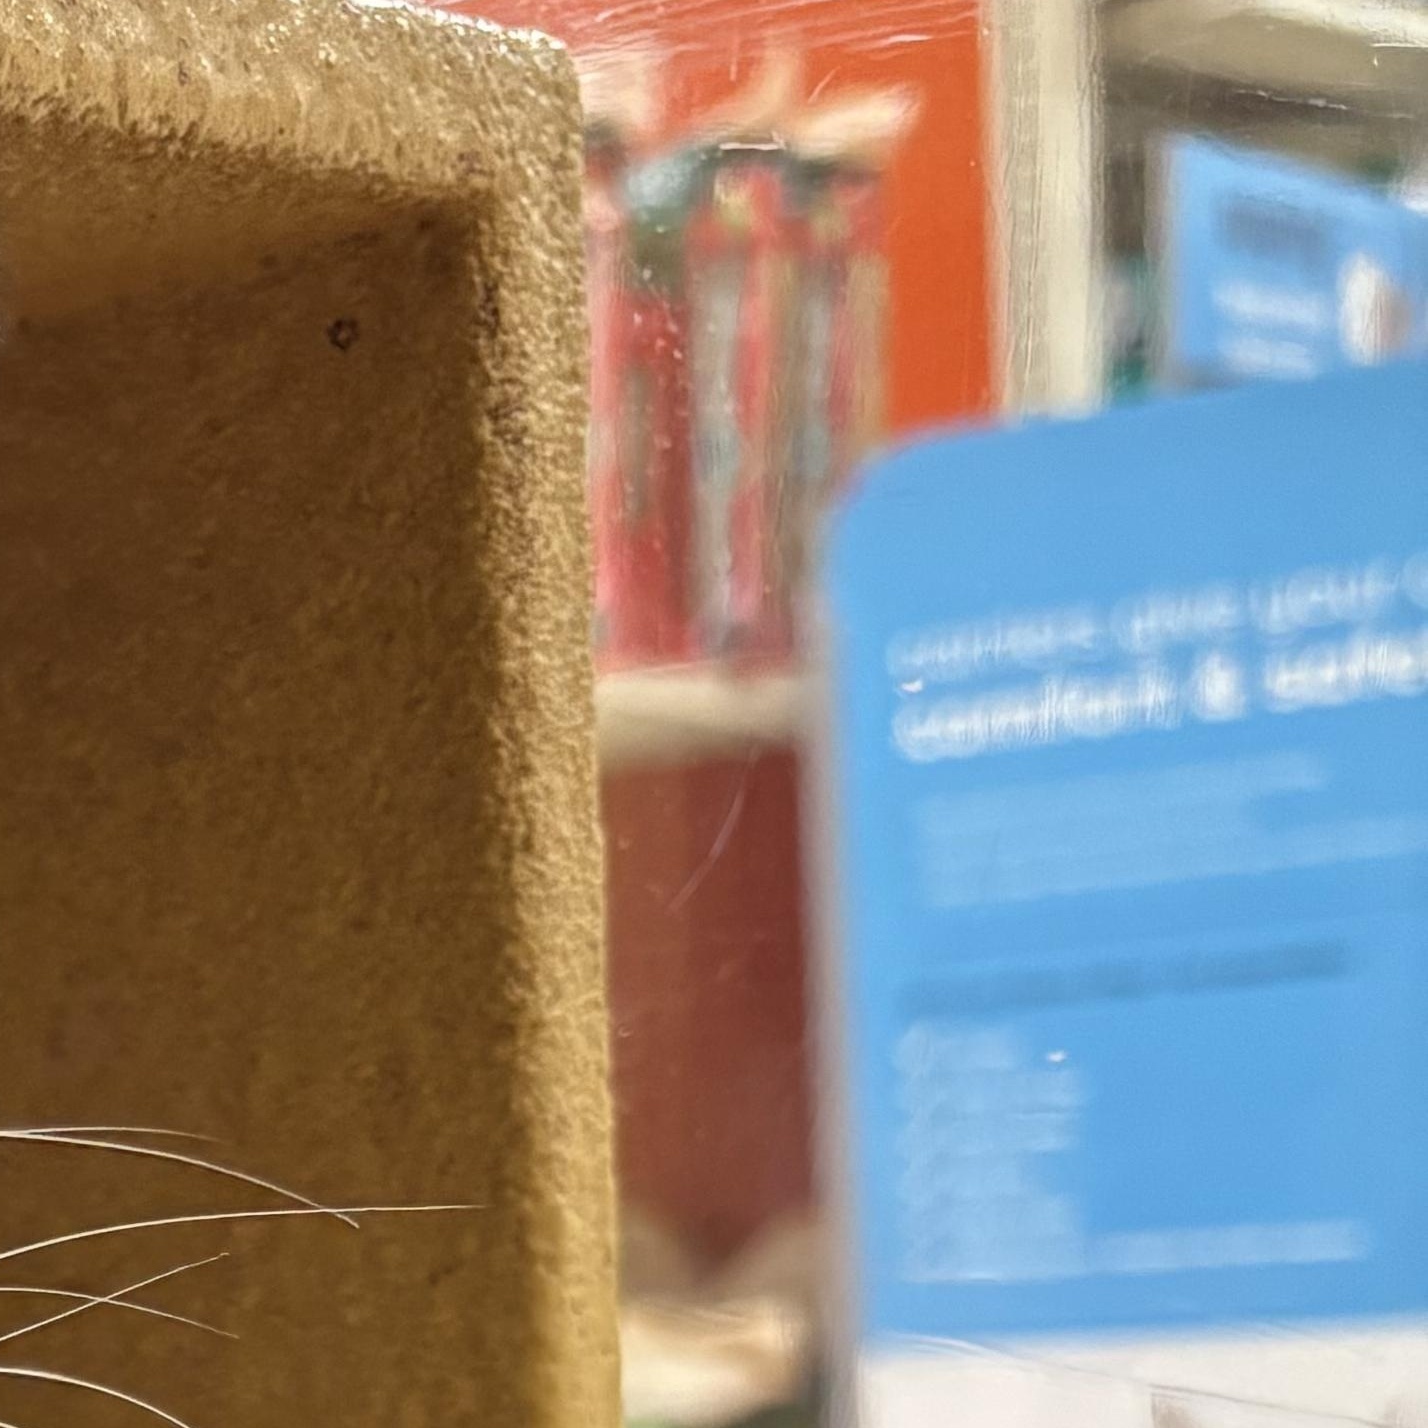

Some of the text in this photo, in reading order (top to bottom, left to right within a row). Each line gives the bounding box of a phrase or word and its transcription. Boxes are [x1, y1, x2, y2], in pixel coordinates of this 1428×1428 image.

[1247, 560, 1399, 640] your
[892, 630, 1428, 764] comfort & safe
